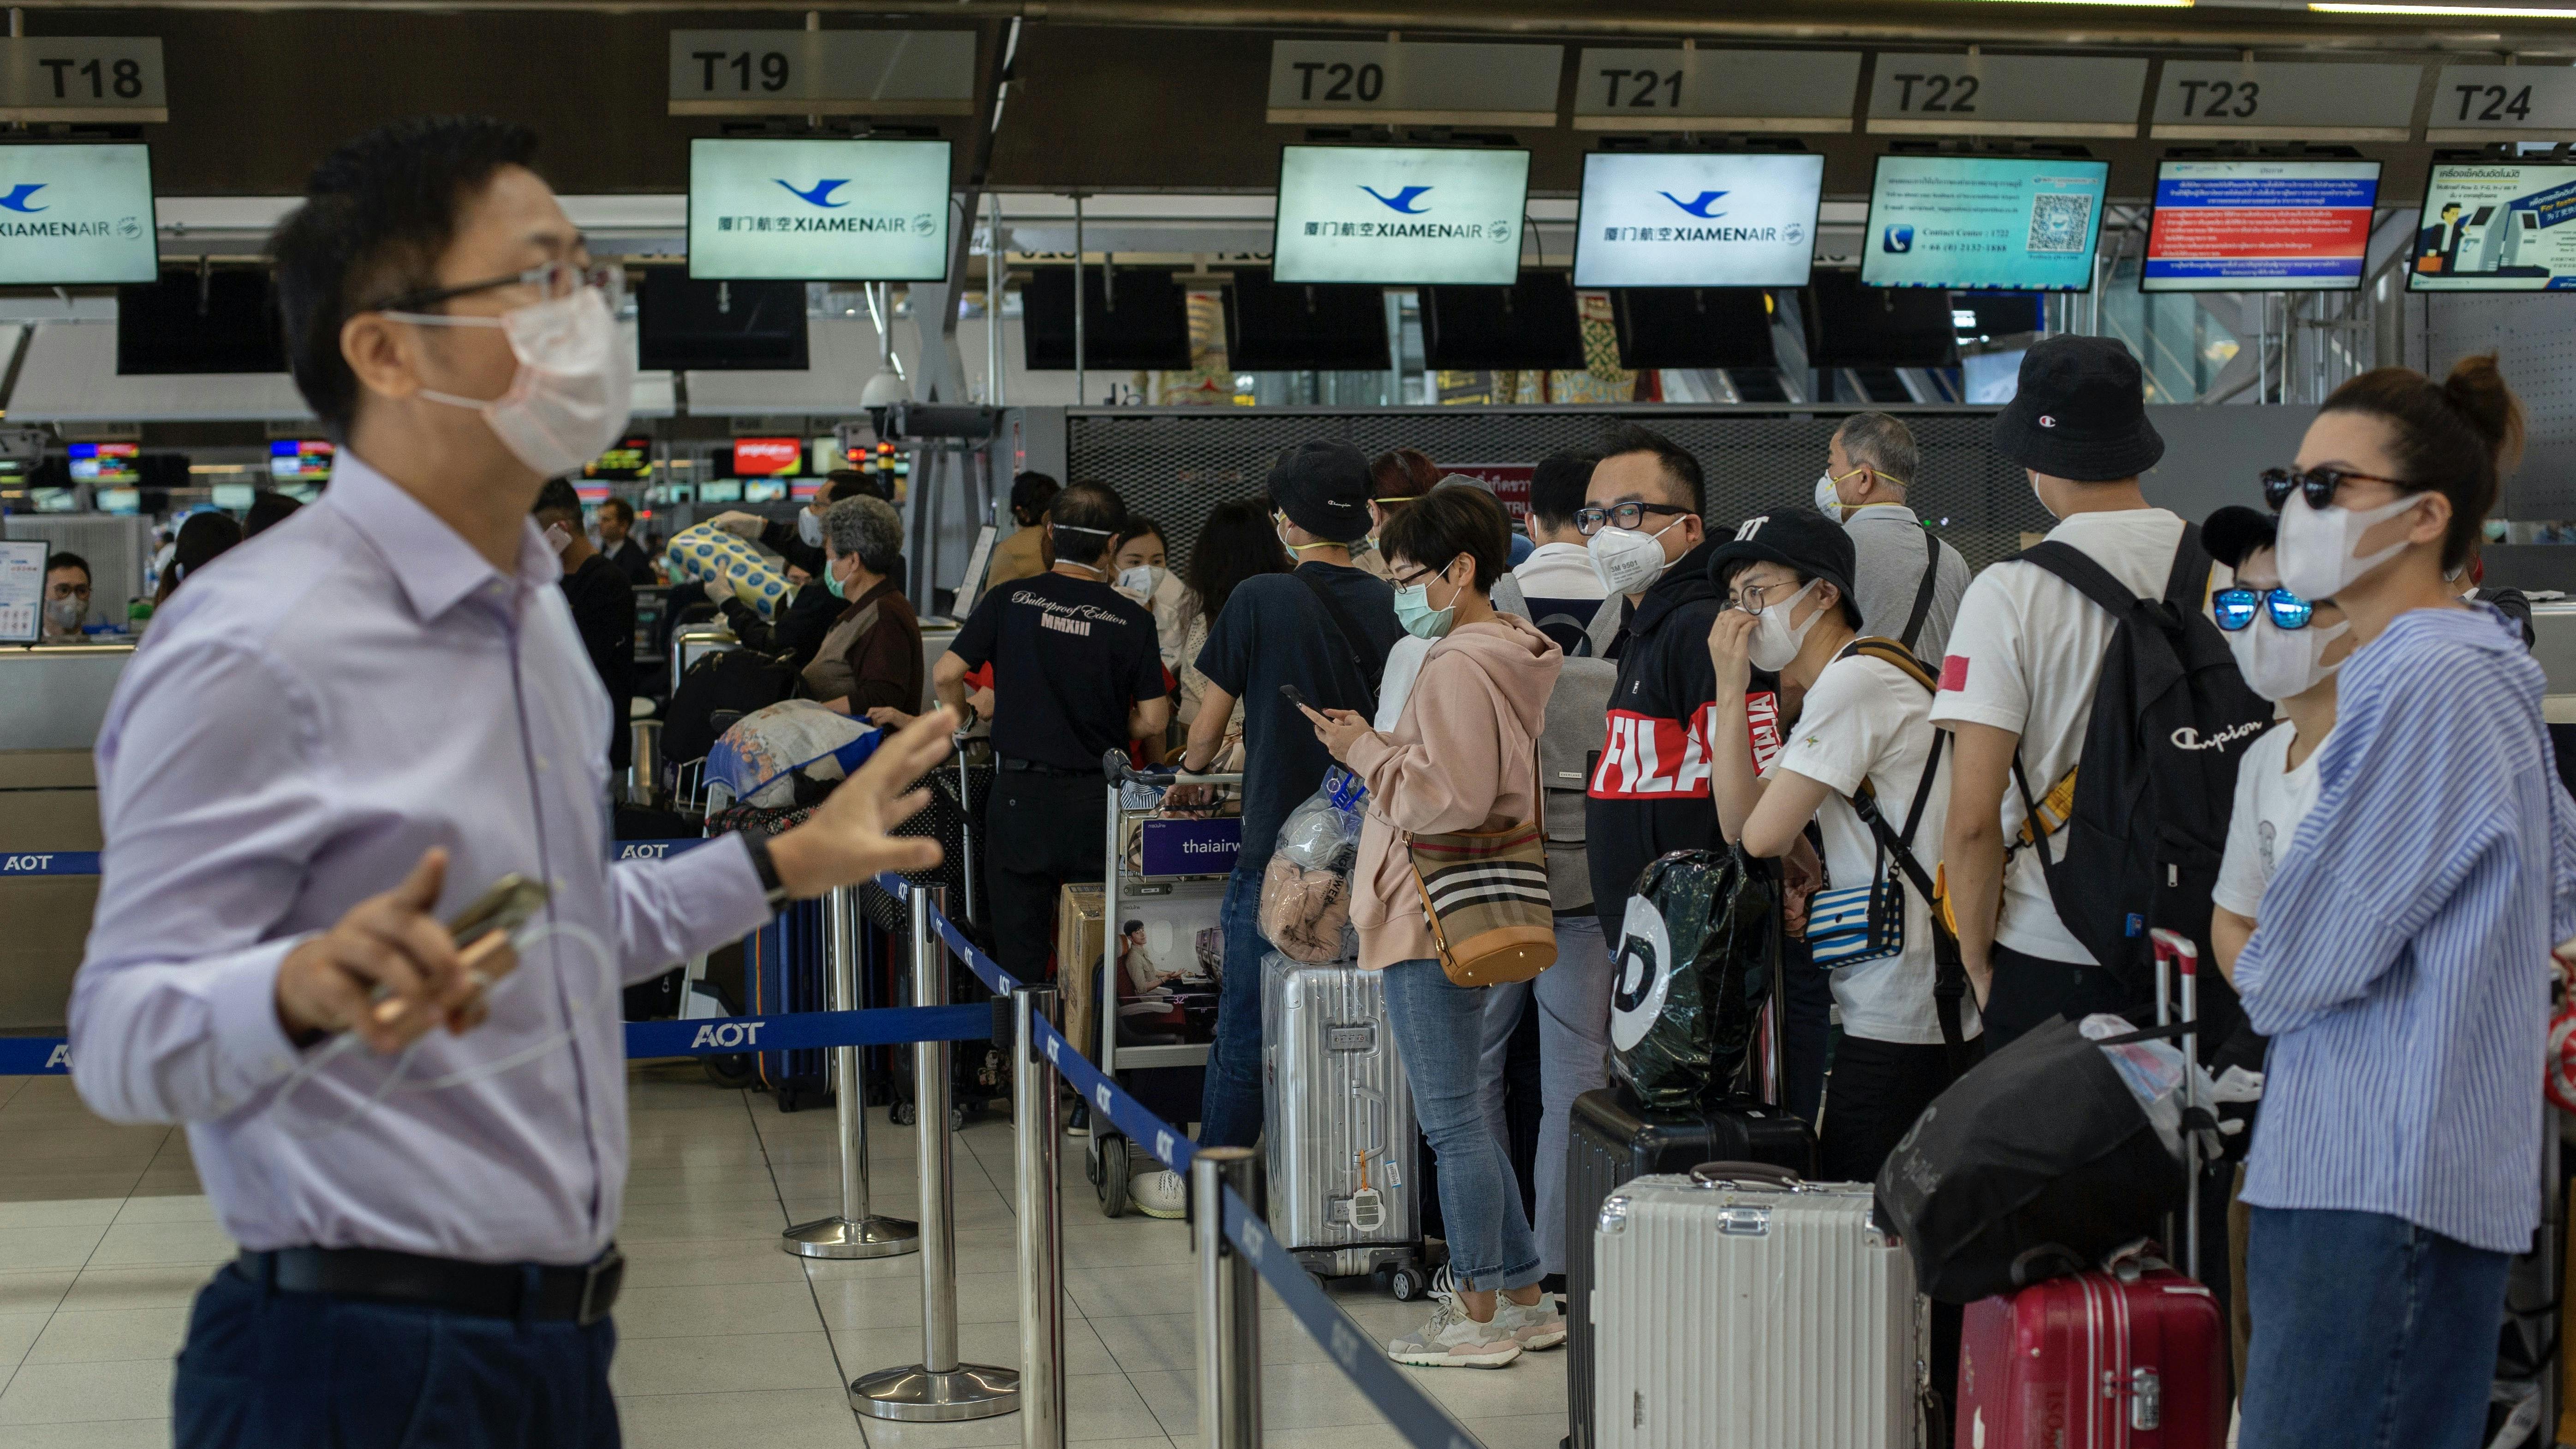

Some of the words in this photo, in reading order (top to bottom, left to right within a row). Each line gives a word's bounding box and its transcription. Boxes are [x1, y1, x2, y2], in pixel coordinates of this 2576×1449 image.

[40, 59, 143, 98] T18
[692, 52, 789, 91] T19
[1294, 62, 1383, 102] T20
[1600, 69, 1683, 107] T21
[1895, 73, 1980, 112] T22
[2179, 80, 2260, 118] T23
[2456, 85, 2533, 120] T24
[1622, 560, 1638, 569] 9501
[1012, 590, 1082, 617] Bulletproof
[1081, 605, 1128, 626] Edition
[1041, 612, 1091, 636] MMXIII
[1594, 715, 1711, 793] FILA
[4, 855, 53, 871] AOT
[621, 844, 669, 859] AOT
[691, 1022, 765, 1048] AOT
